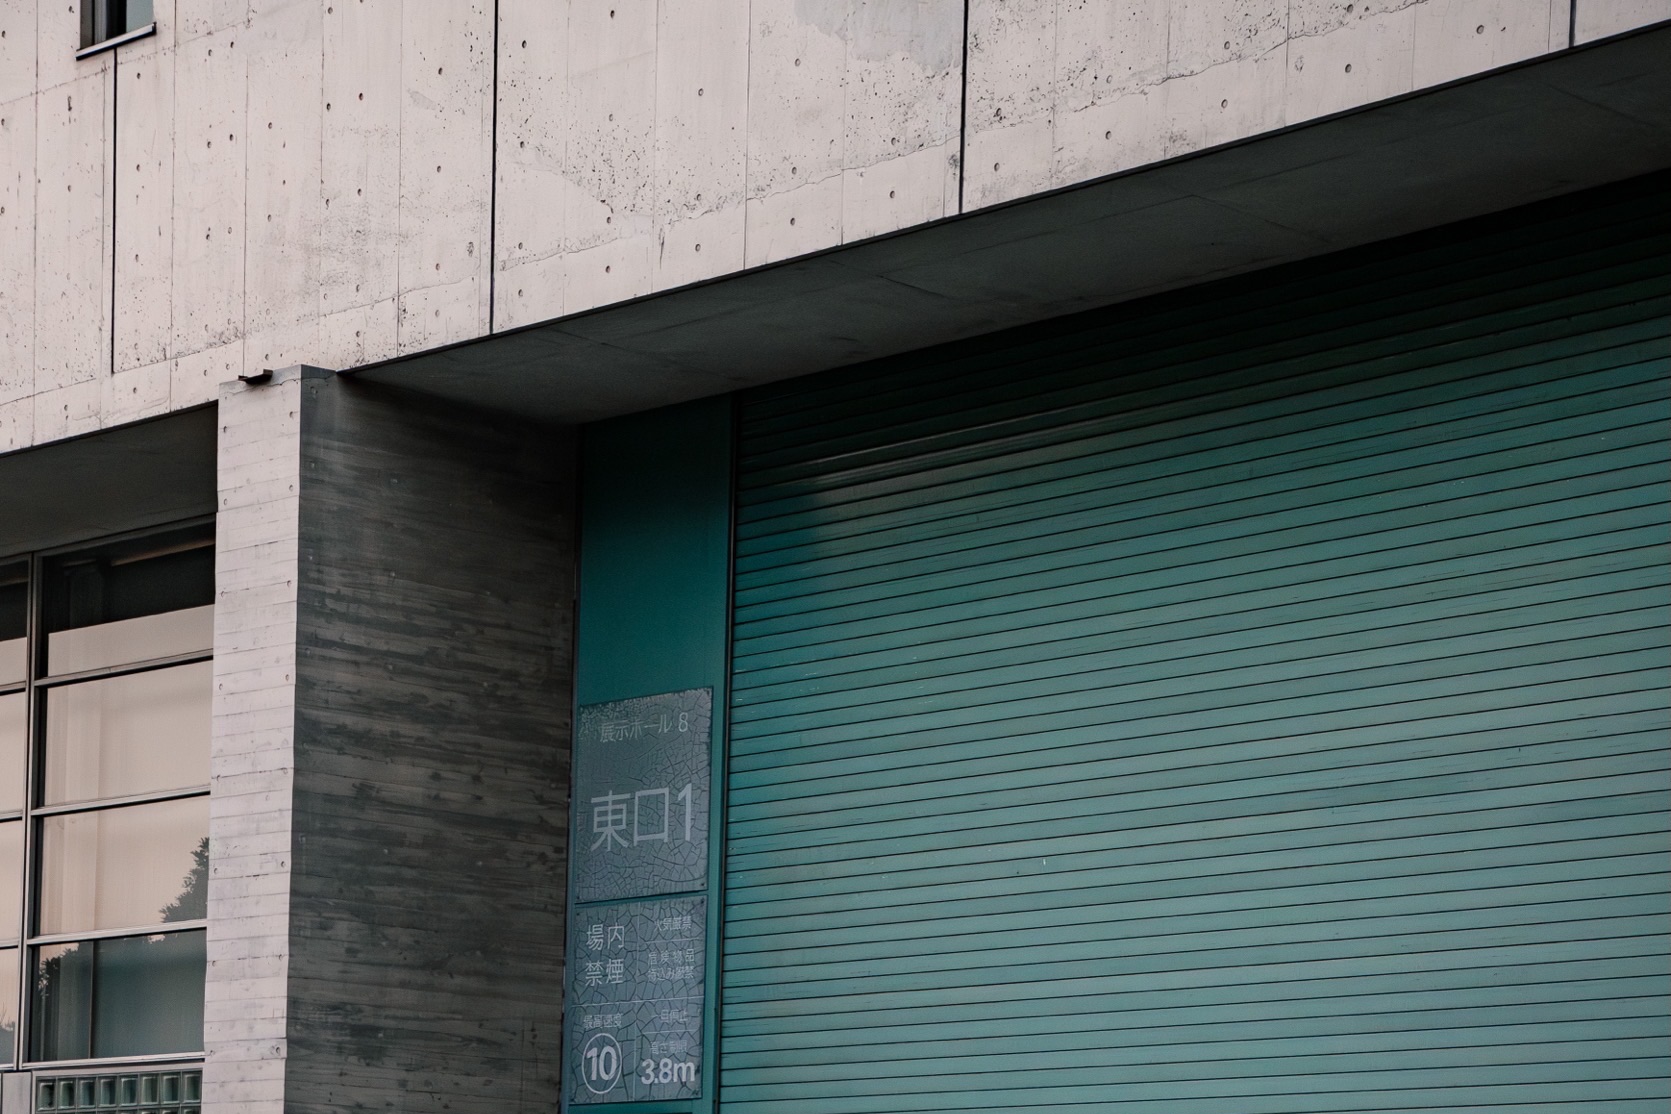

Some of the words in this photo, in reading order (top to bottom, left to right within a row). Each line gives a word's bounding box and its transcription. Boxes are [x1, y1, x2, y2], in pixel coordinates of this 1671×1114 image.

[586, 922, 625, 950] 場内
[585, 958, 624, 987] 禁煙
[586, 1045, 617, 1081] 10
[641, 1058, 696, 1085] 3.8m
